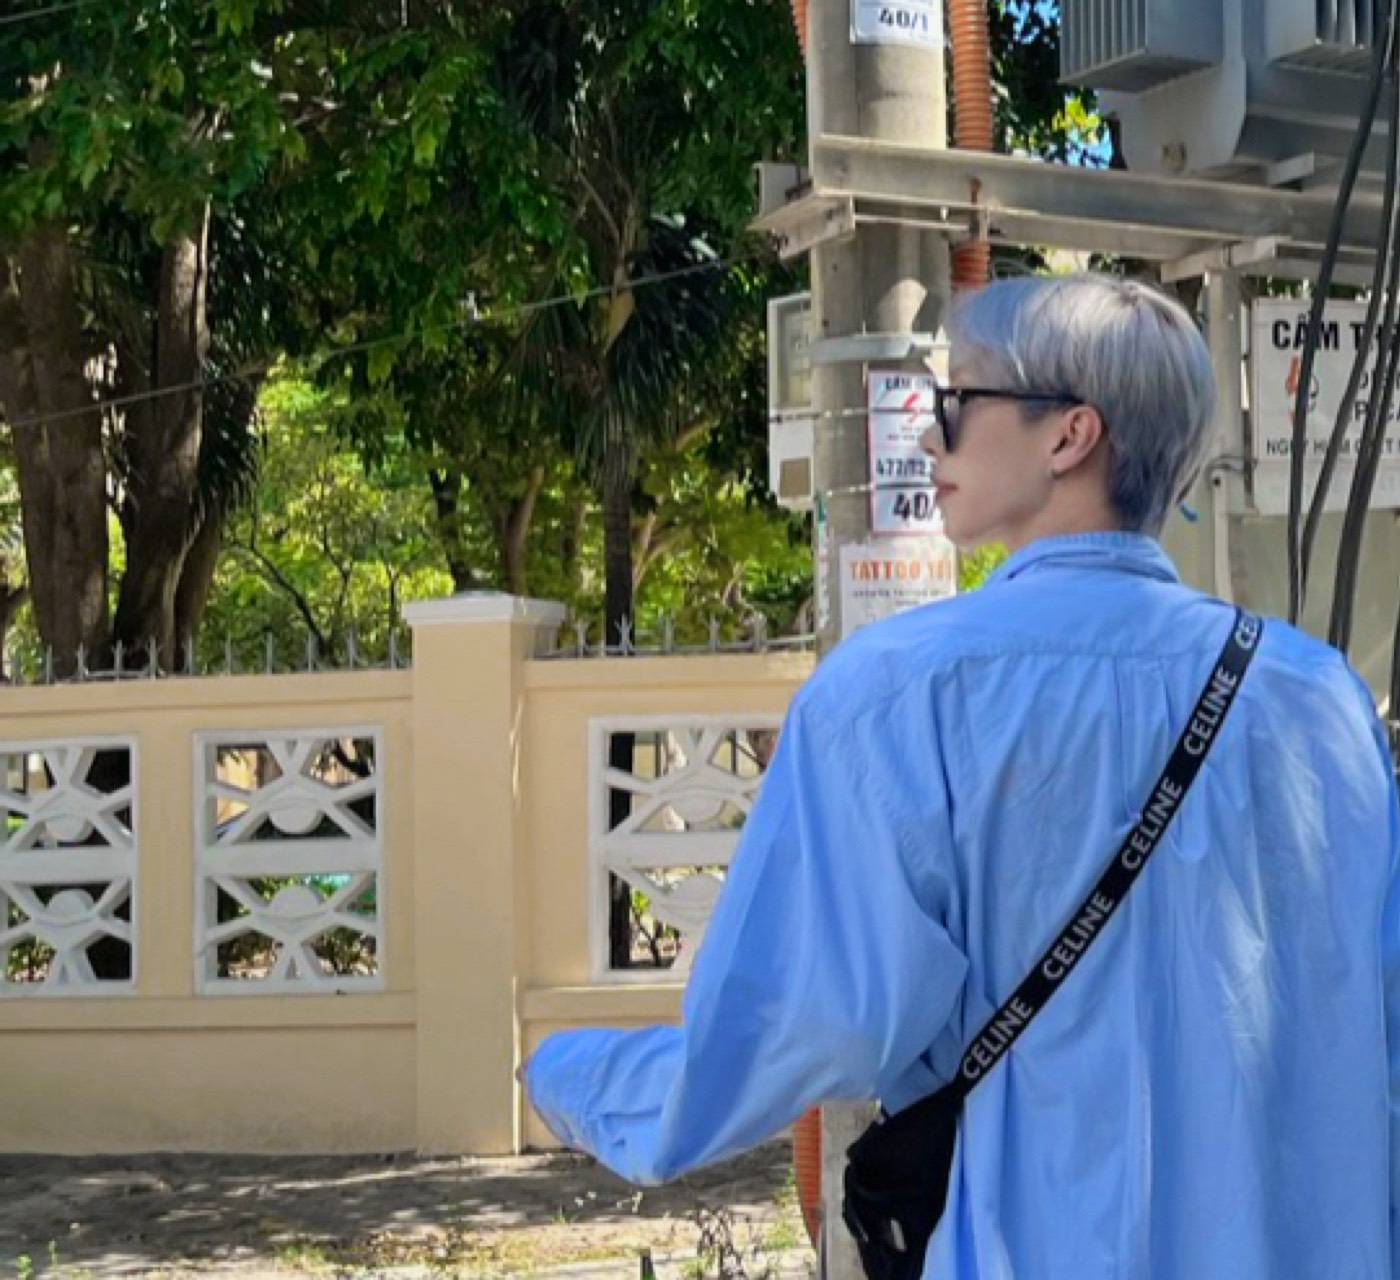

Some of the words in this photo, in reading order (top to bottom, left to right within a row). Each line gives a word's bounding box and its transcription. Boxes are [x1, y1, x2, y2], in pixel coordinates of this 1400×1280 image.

[1183, 666, 1238, 756] CELINE
[1121, 775, 1183, 870] CELINE
[1042, 892, 1114, 981] CELINE
[962, 996, 1034, 1080] CELINE
